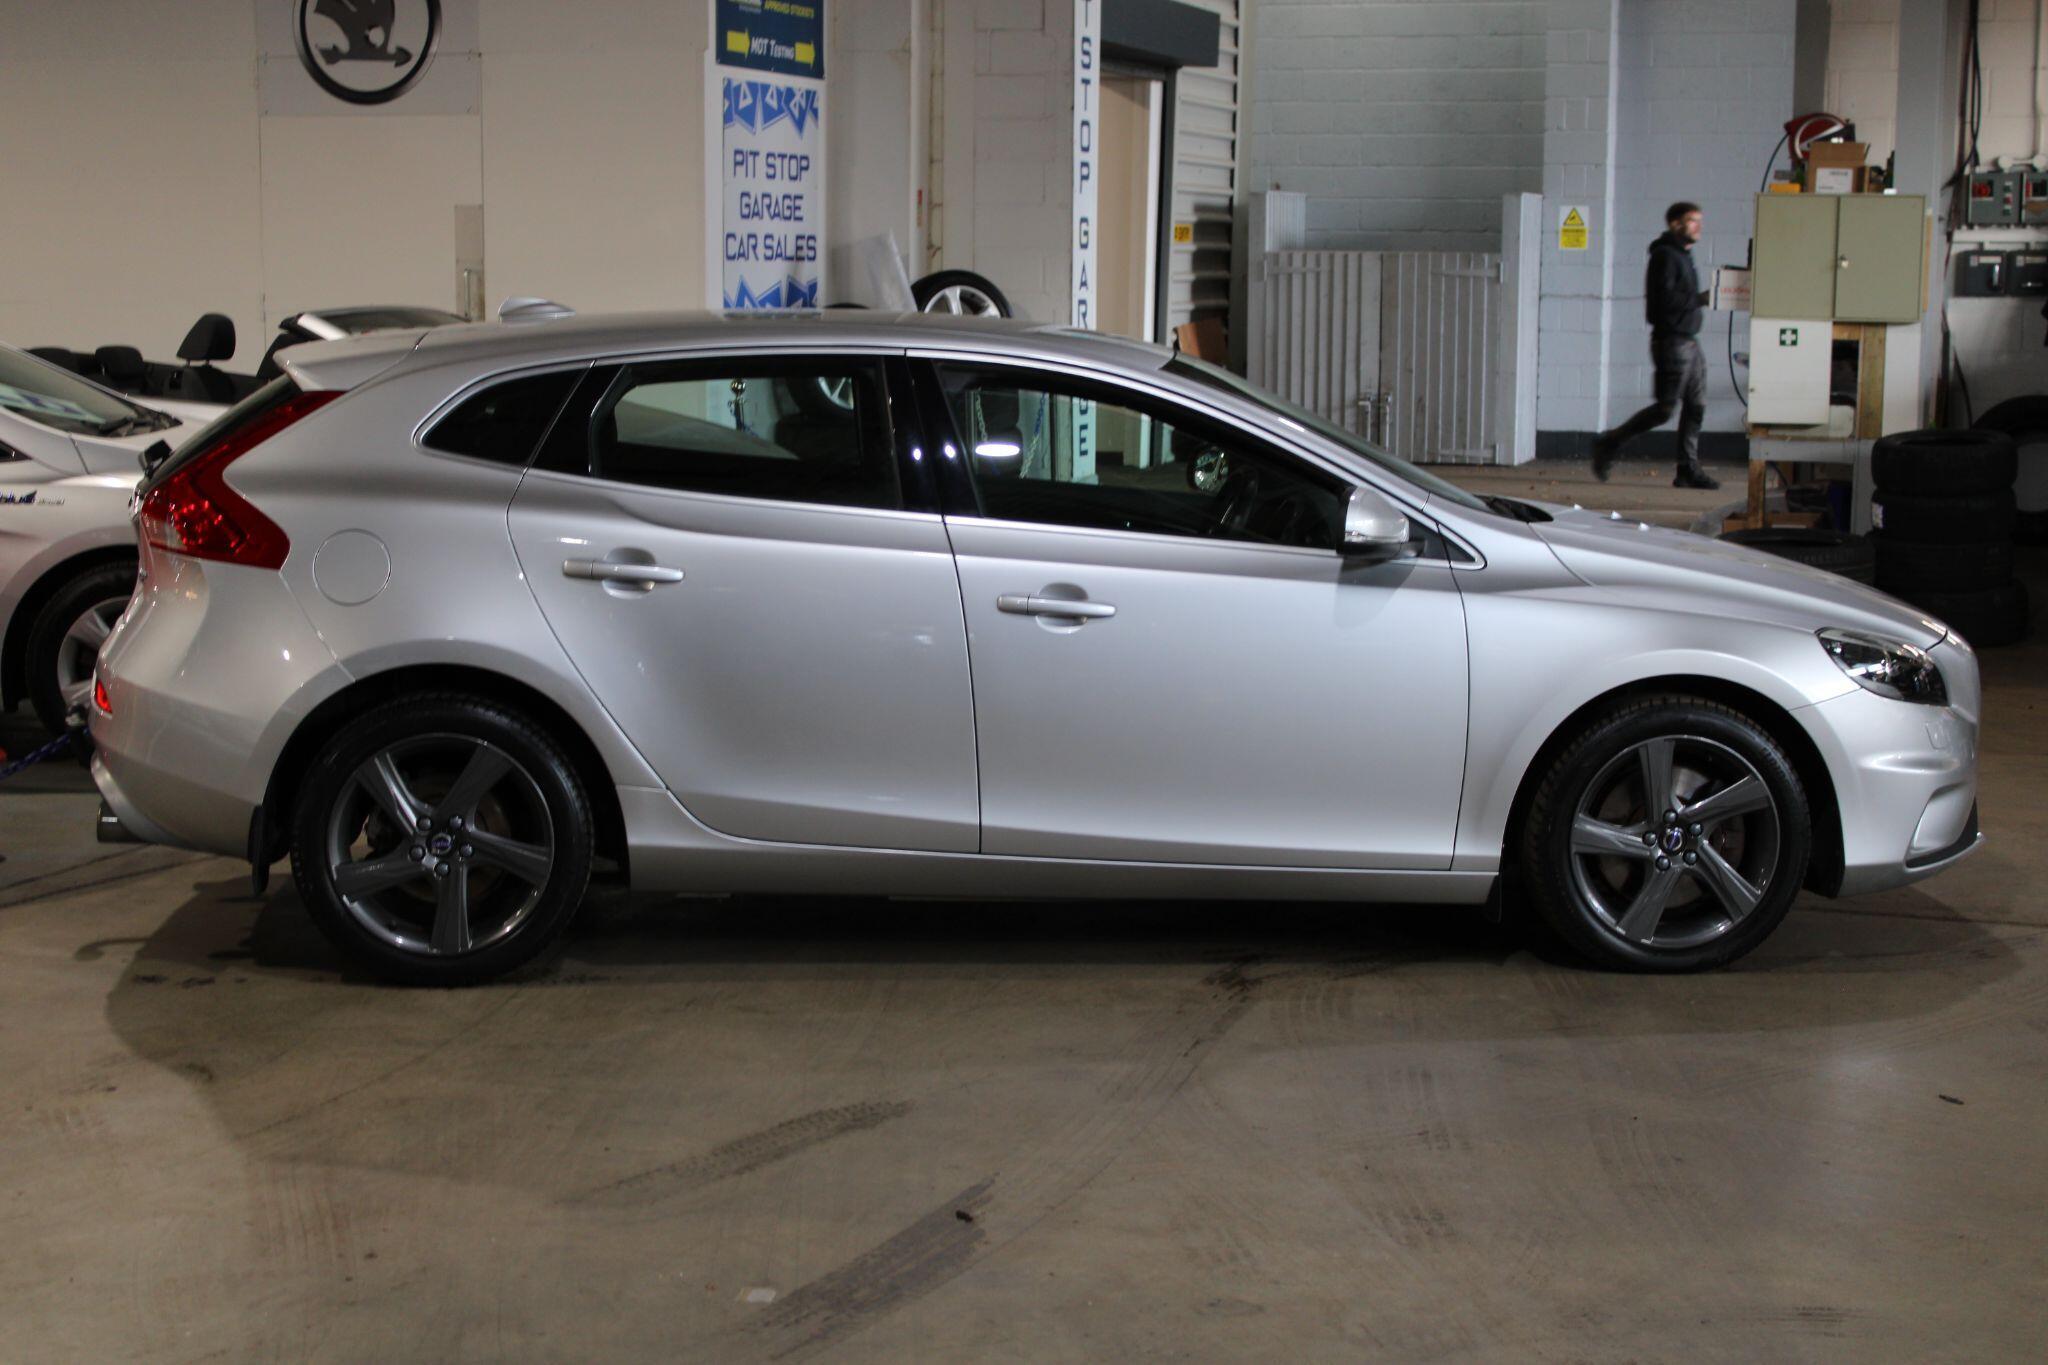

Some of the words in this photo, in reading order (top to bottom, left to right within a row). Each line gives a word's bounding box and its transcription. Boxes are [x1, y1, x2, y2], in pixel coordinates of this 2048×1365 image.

[751, 36, 769, 56] MOT
[733, 149, 760, 178] PIT
[766, 152, 810, 182] STOP
[740, 191, 804, 221] GARAGE
[725, 232, 759, 261] CAR
[763, 233, 817, 262] SALES
